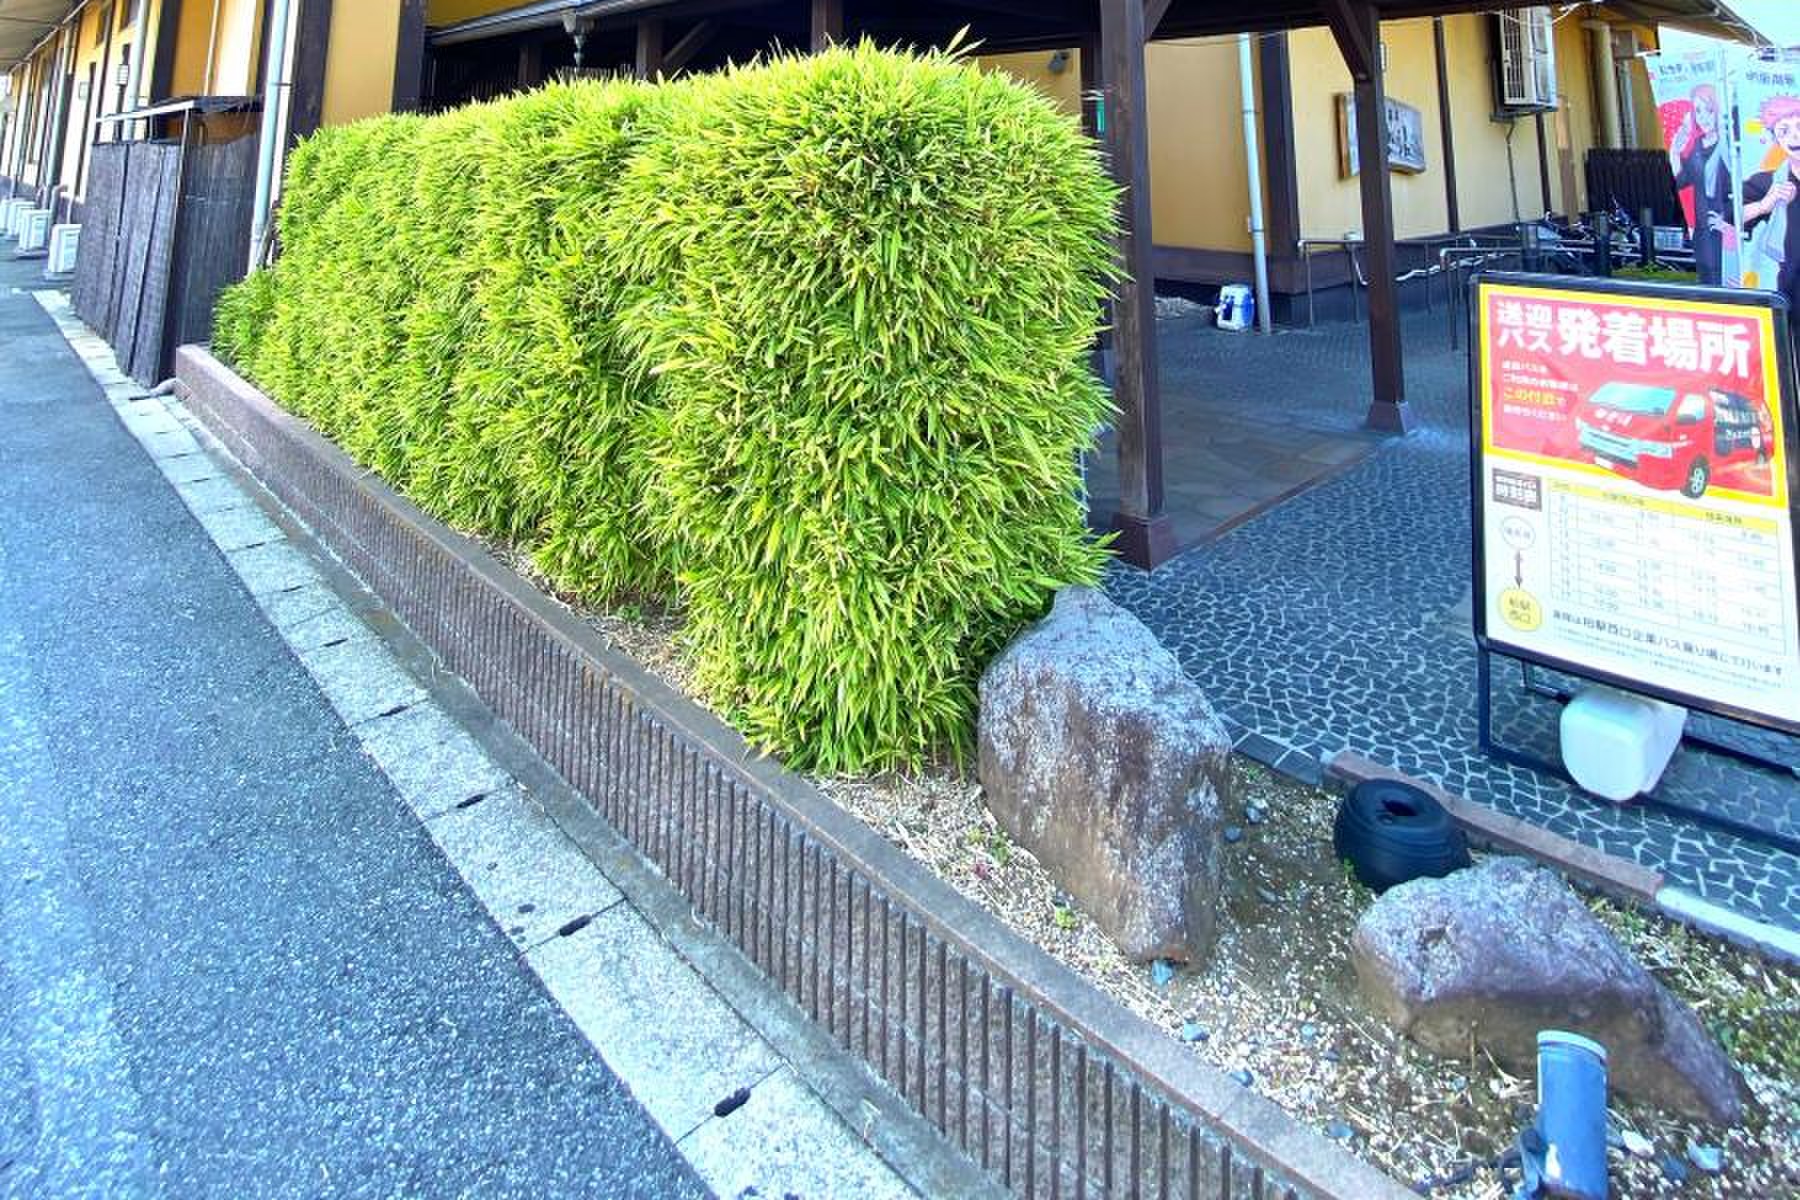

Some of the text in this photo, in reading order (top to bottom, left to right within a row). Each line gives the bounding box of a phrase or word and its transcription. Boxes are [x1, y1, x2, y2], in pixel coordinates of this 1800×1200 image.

[1497, 300, 1552, 327] 送迎
[1497, 327, 1552, 353] バス
[1557, 306, 1750, 378] 発着場所
